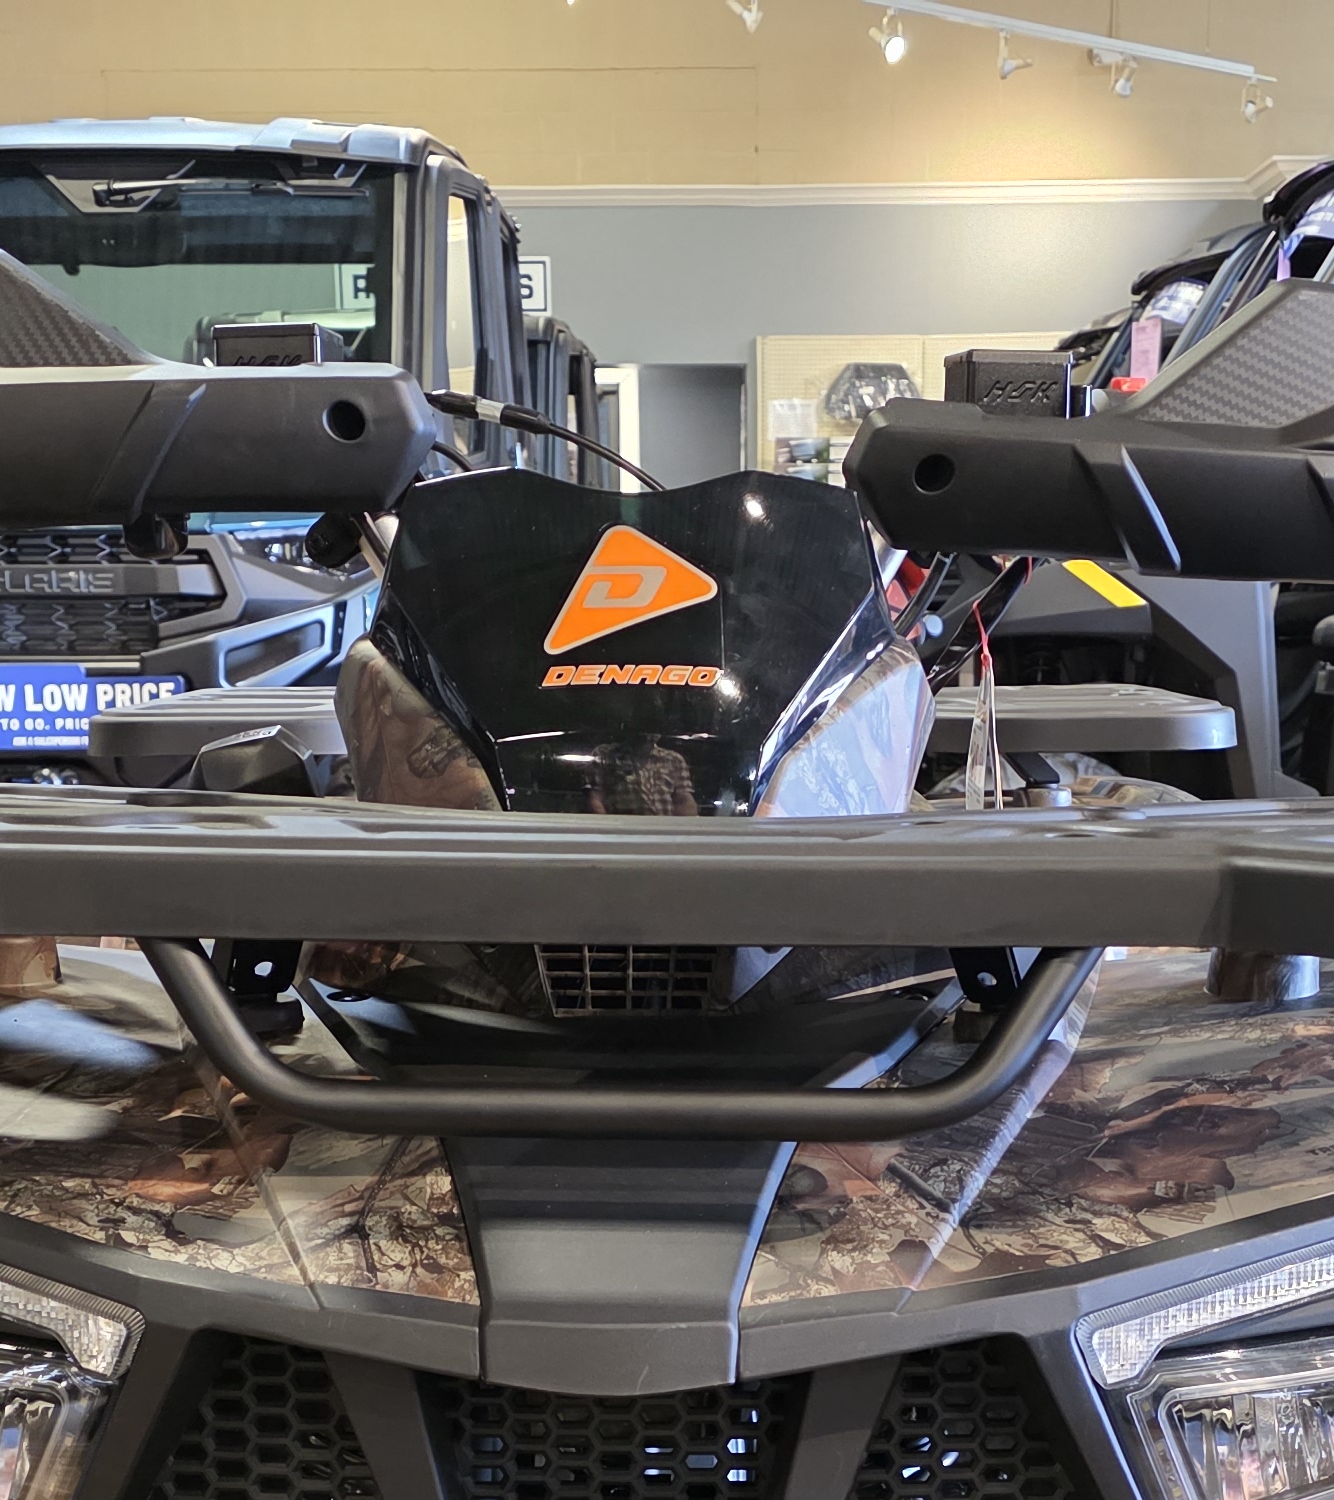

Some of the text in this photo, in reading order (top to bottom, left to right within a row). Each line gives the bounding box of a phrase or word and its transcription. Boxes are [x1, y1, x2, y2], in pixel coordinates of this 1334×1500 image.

[540, 664, 722, 688] DENAGO
[23, 683, 89, 713] LOW
[95, 681, 176, 711] PRICE
[0, 717, 20, 732] TO
[54, 717, 90, 731] PRIC
